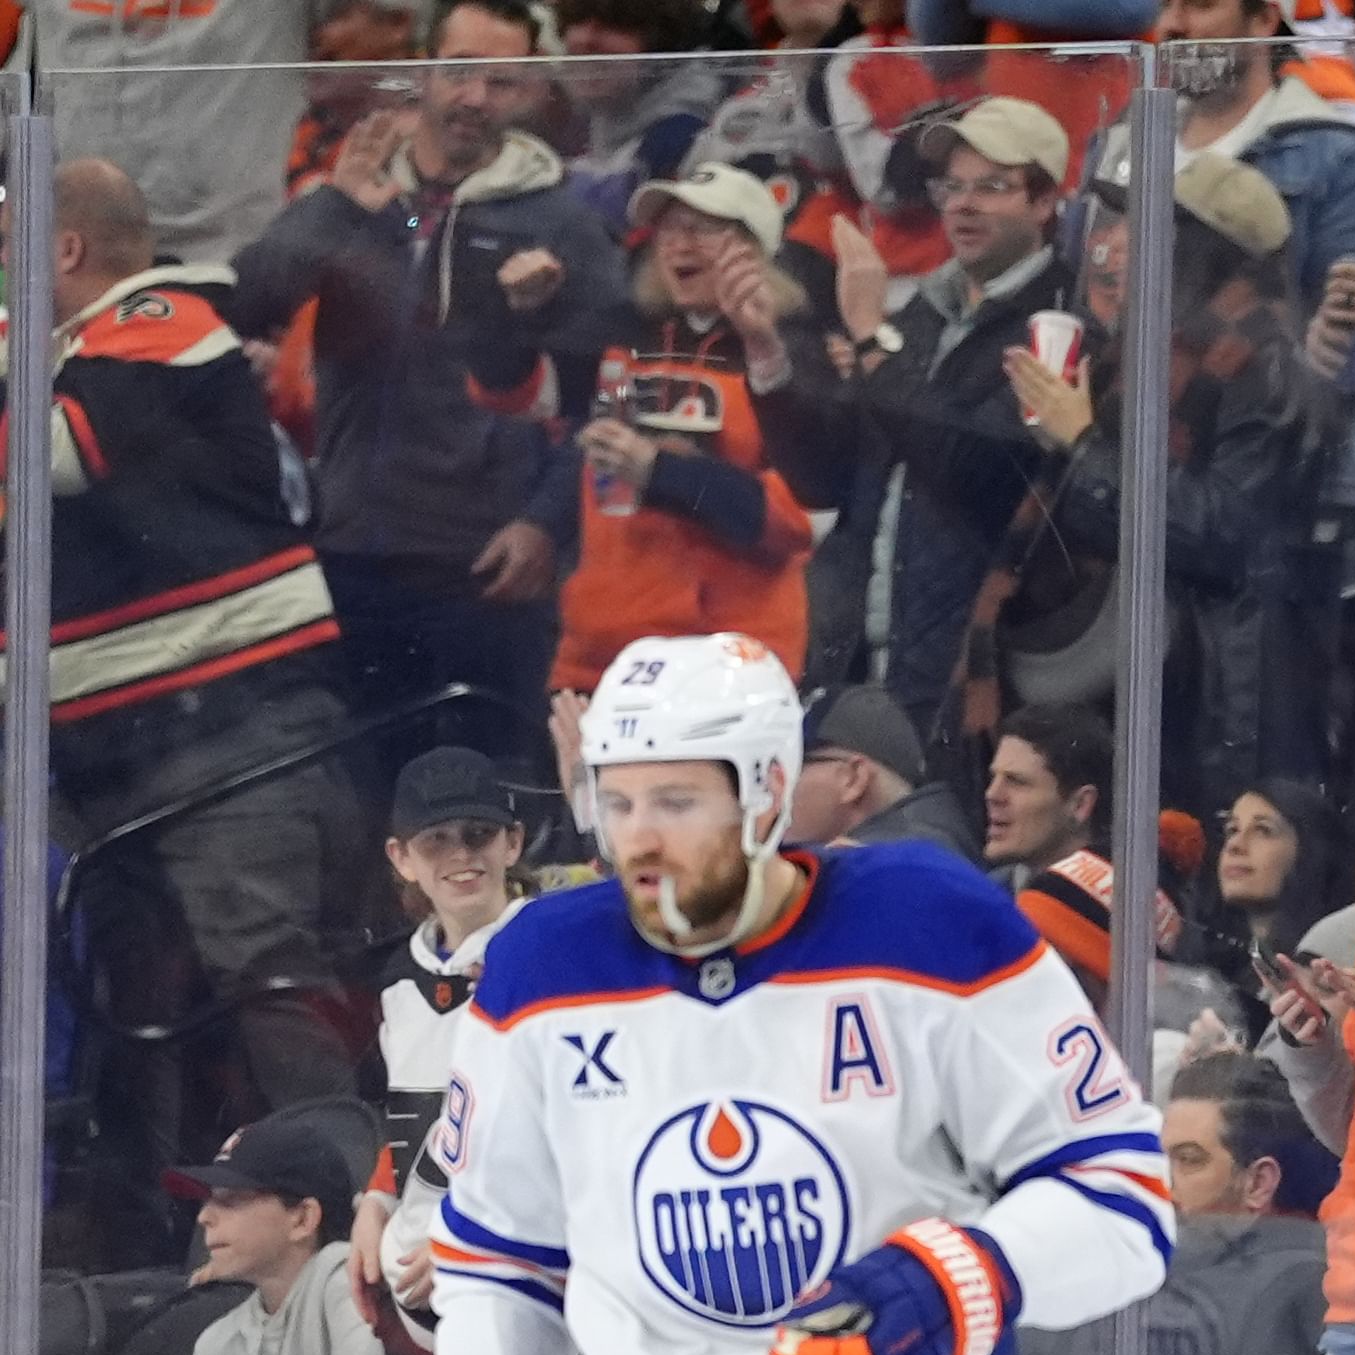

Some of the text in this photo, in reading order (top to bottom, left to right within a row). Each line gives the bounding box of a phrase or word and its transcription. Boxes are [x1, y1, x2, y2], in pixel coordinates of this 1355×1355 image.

[620, 660, 666, 686] 29
[822, 993, 895, 1103] A
[651, 1177, 824, 1300] OILERS
